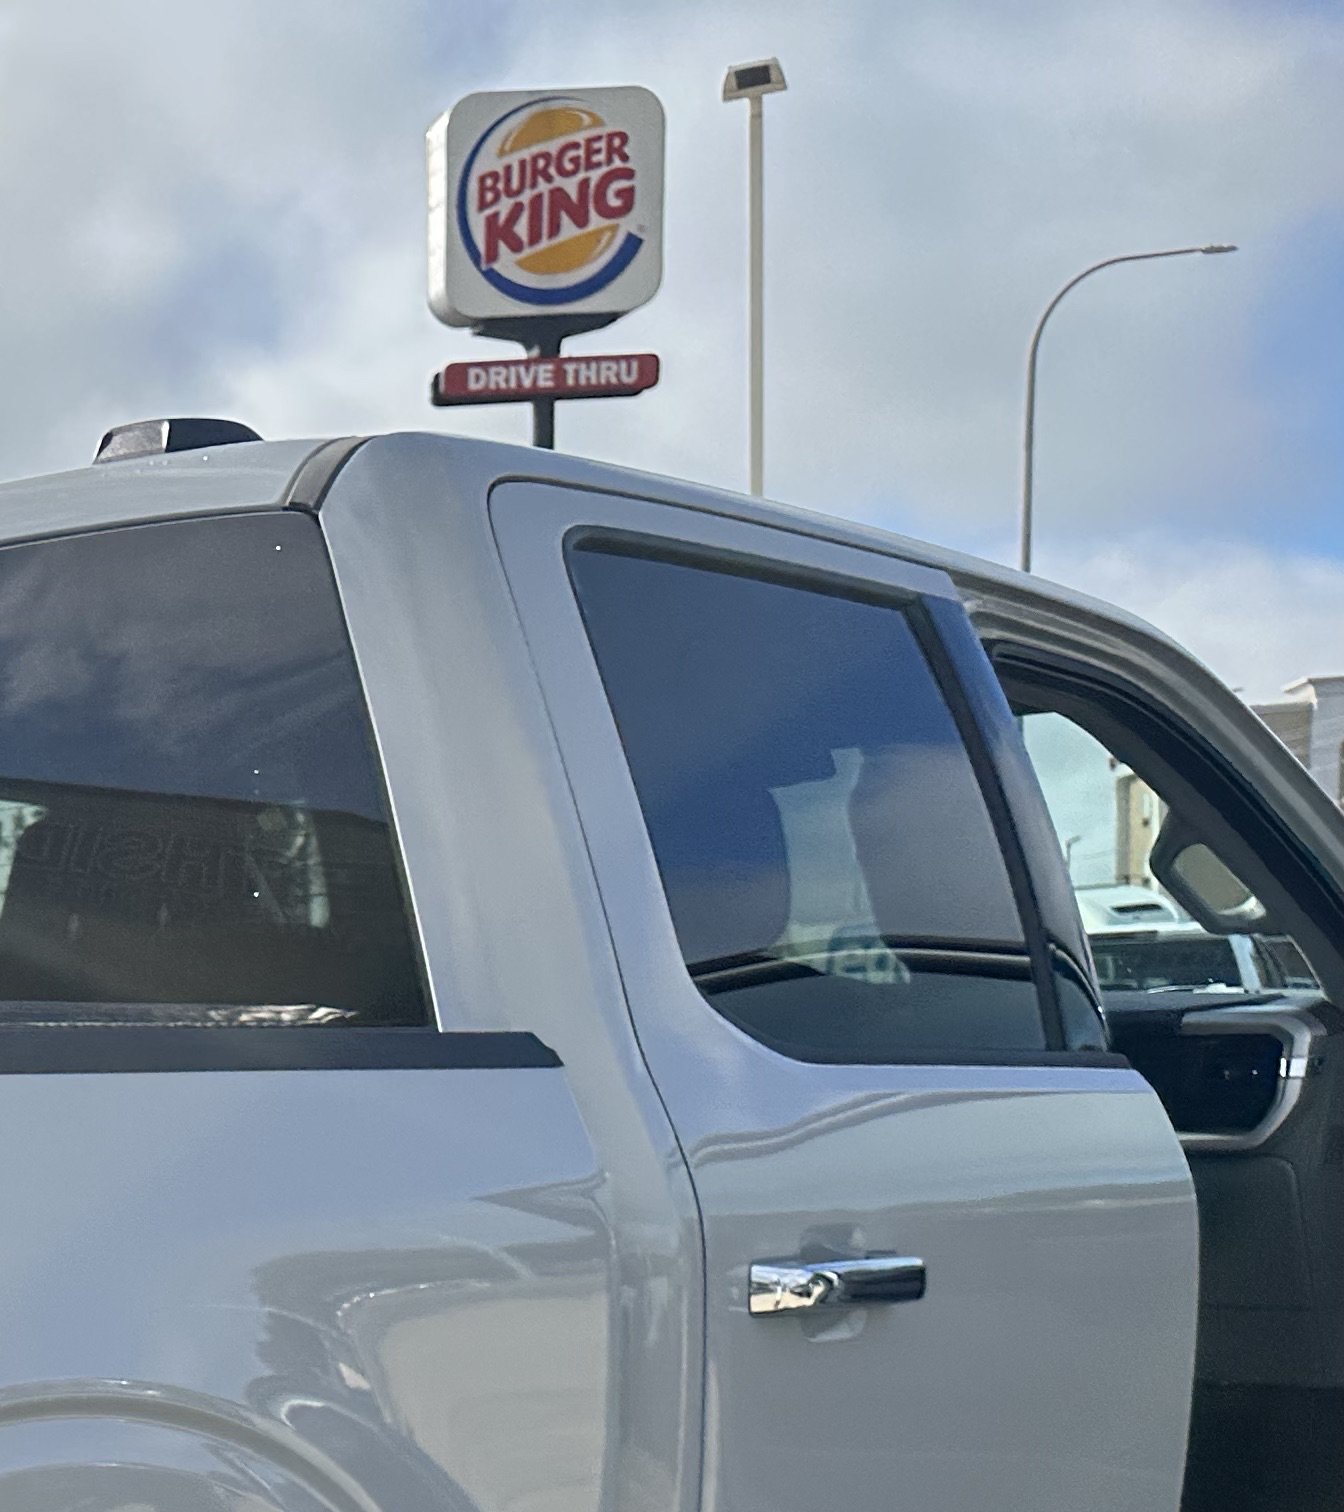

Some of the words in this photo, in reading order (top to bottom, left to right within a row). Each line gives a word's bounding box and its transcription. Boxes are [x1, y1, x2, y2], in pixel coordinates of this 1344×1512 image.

[477, 131, 630, 213] BURGER
[485, 167, 636, 265] KING
[467, 363, 555, 391] DRIVE
[563, 360, 639, 386] THRU
